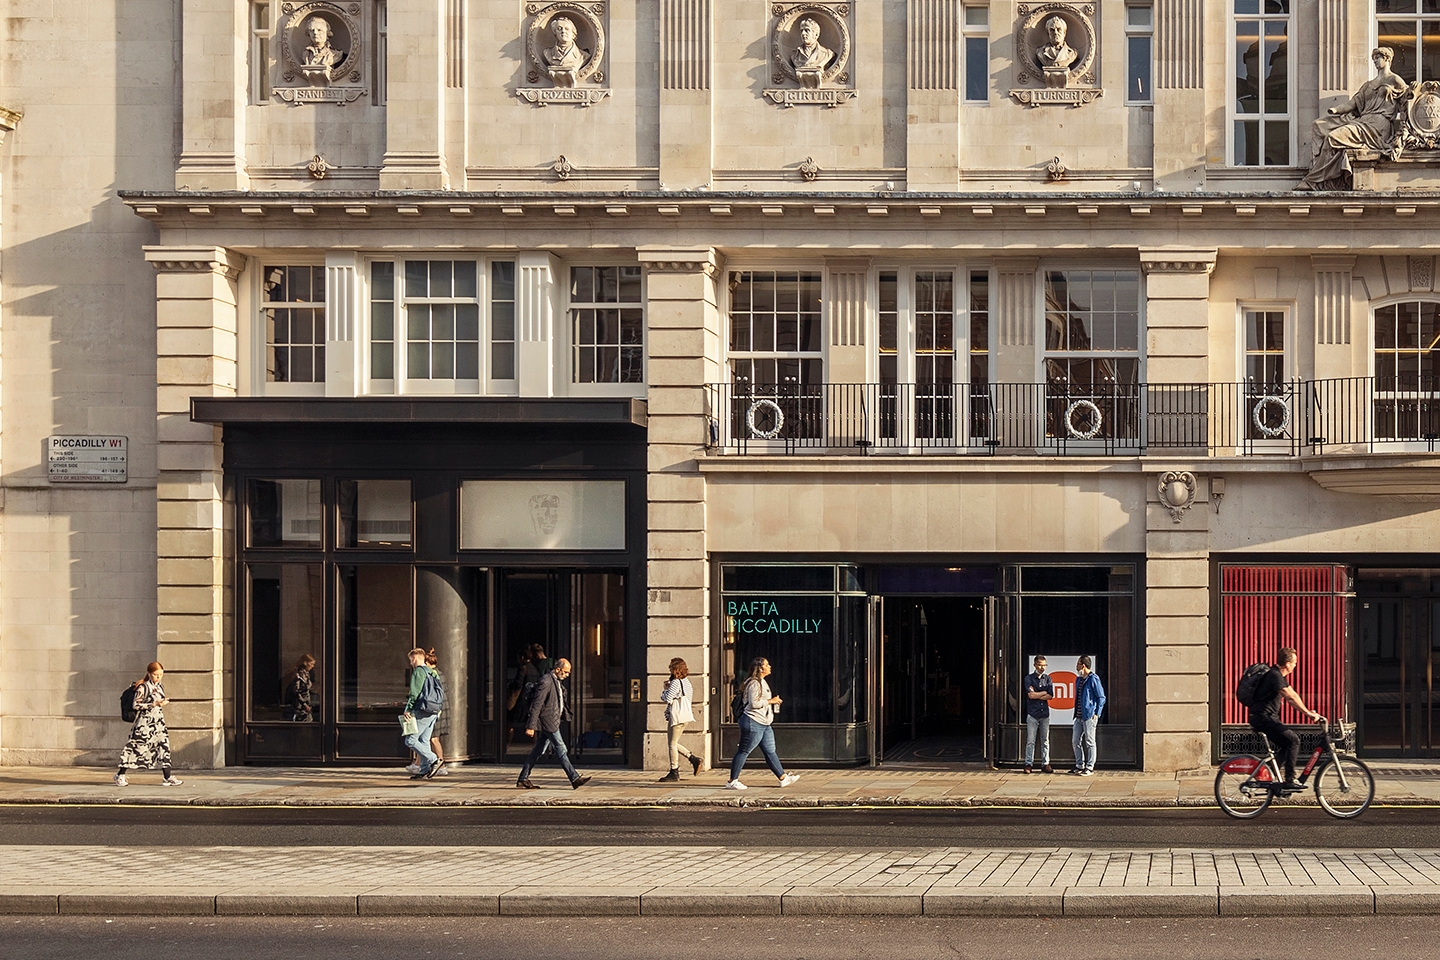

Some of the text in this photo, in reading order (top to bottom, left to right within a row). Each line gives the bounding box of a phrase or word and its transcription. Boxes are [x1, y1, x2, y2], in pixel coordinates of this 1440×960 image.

[297, 89, 340, 99] SANDBY
[542, 89, 585, 100] COZENS
[788, 90, 832, 101] GIRTIN
[1036, 90, 1078, 100] TURNER
[53, 439, 122, 447] PICCADILLY W1
[728, 601, 779, 616] BAFTA
[728, 619, 822, 633] PICCADILLY
